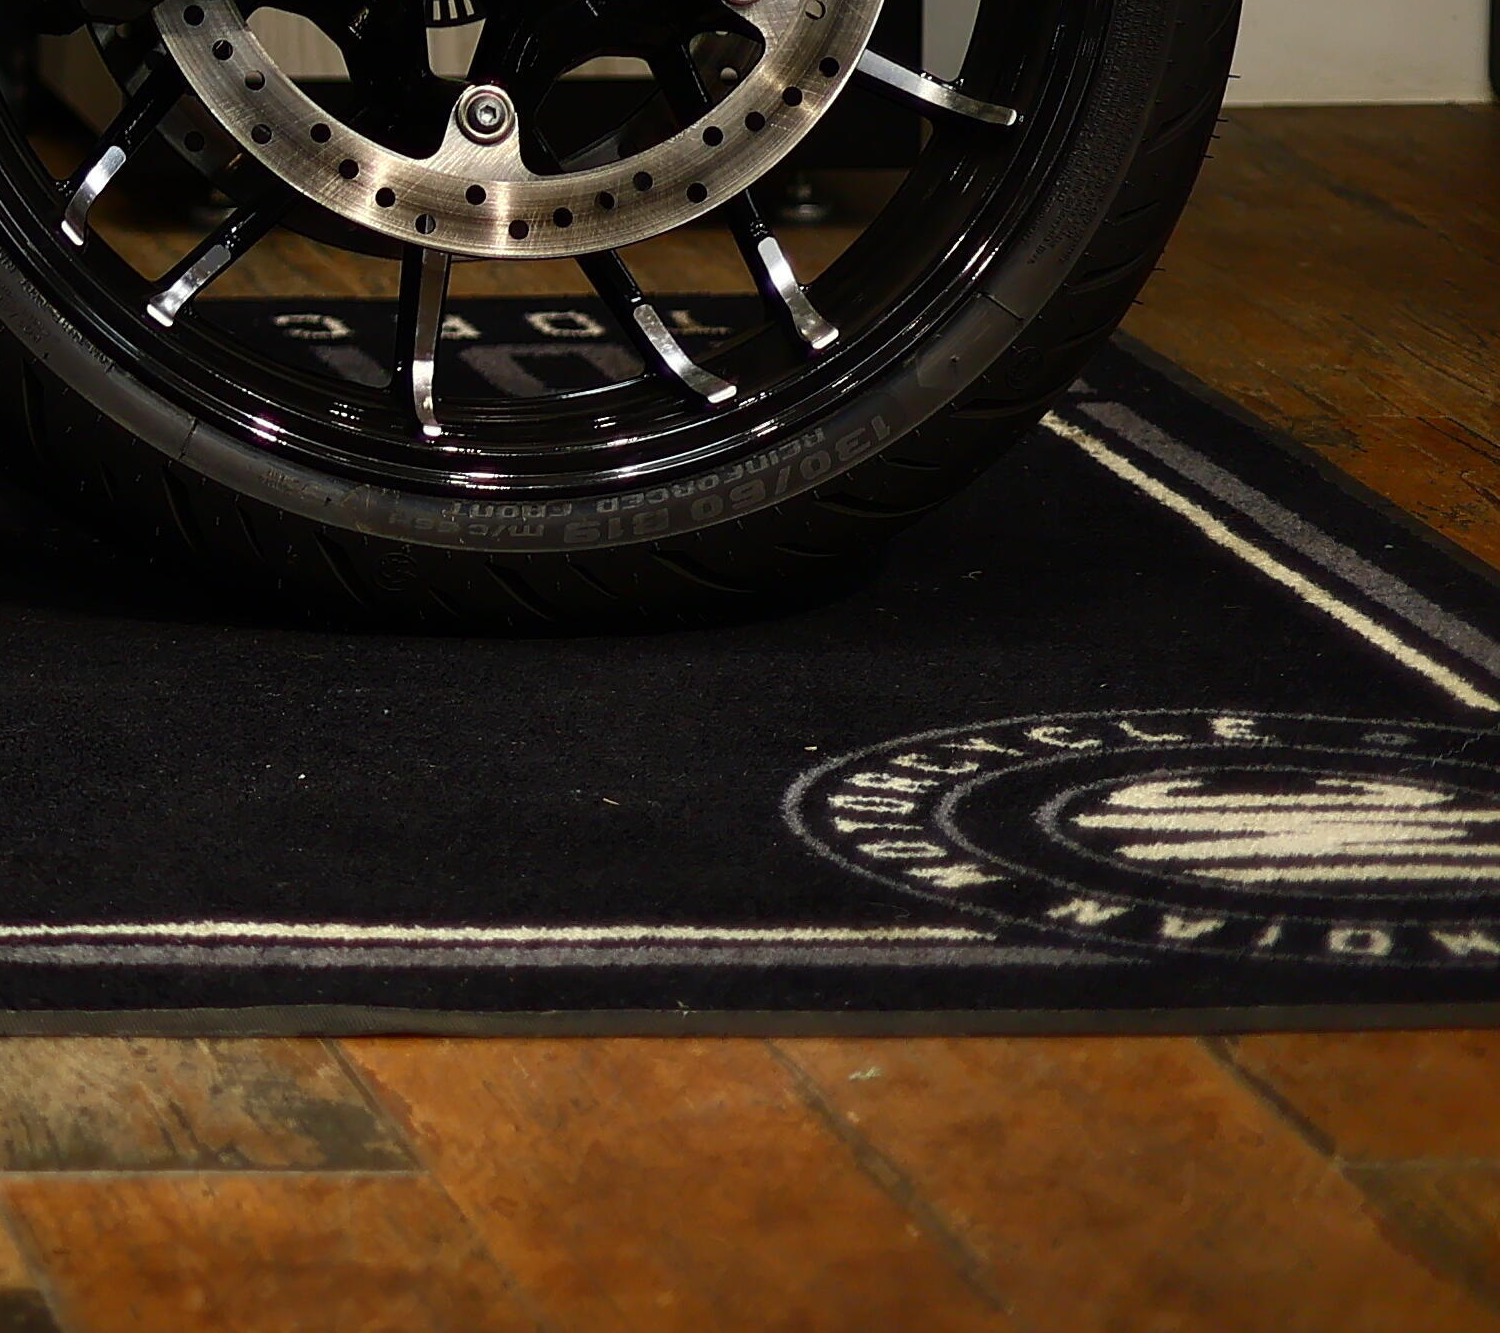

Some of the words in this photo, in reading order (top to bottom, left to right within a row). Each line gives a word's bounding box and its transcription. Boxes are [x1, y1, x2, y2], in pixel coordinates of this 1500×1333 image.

[595, 426, 826, 514] REINFORCED
[689, 414, 894, 521] 130/60
[441, 499, 573, 520] FRONT
[1046, 895, 1500, 959] NDIAN
